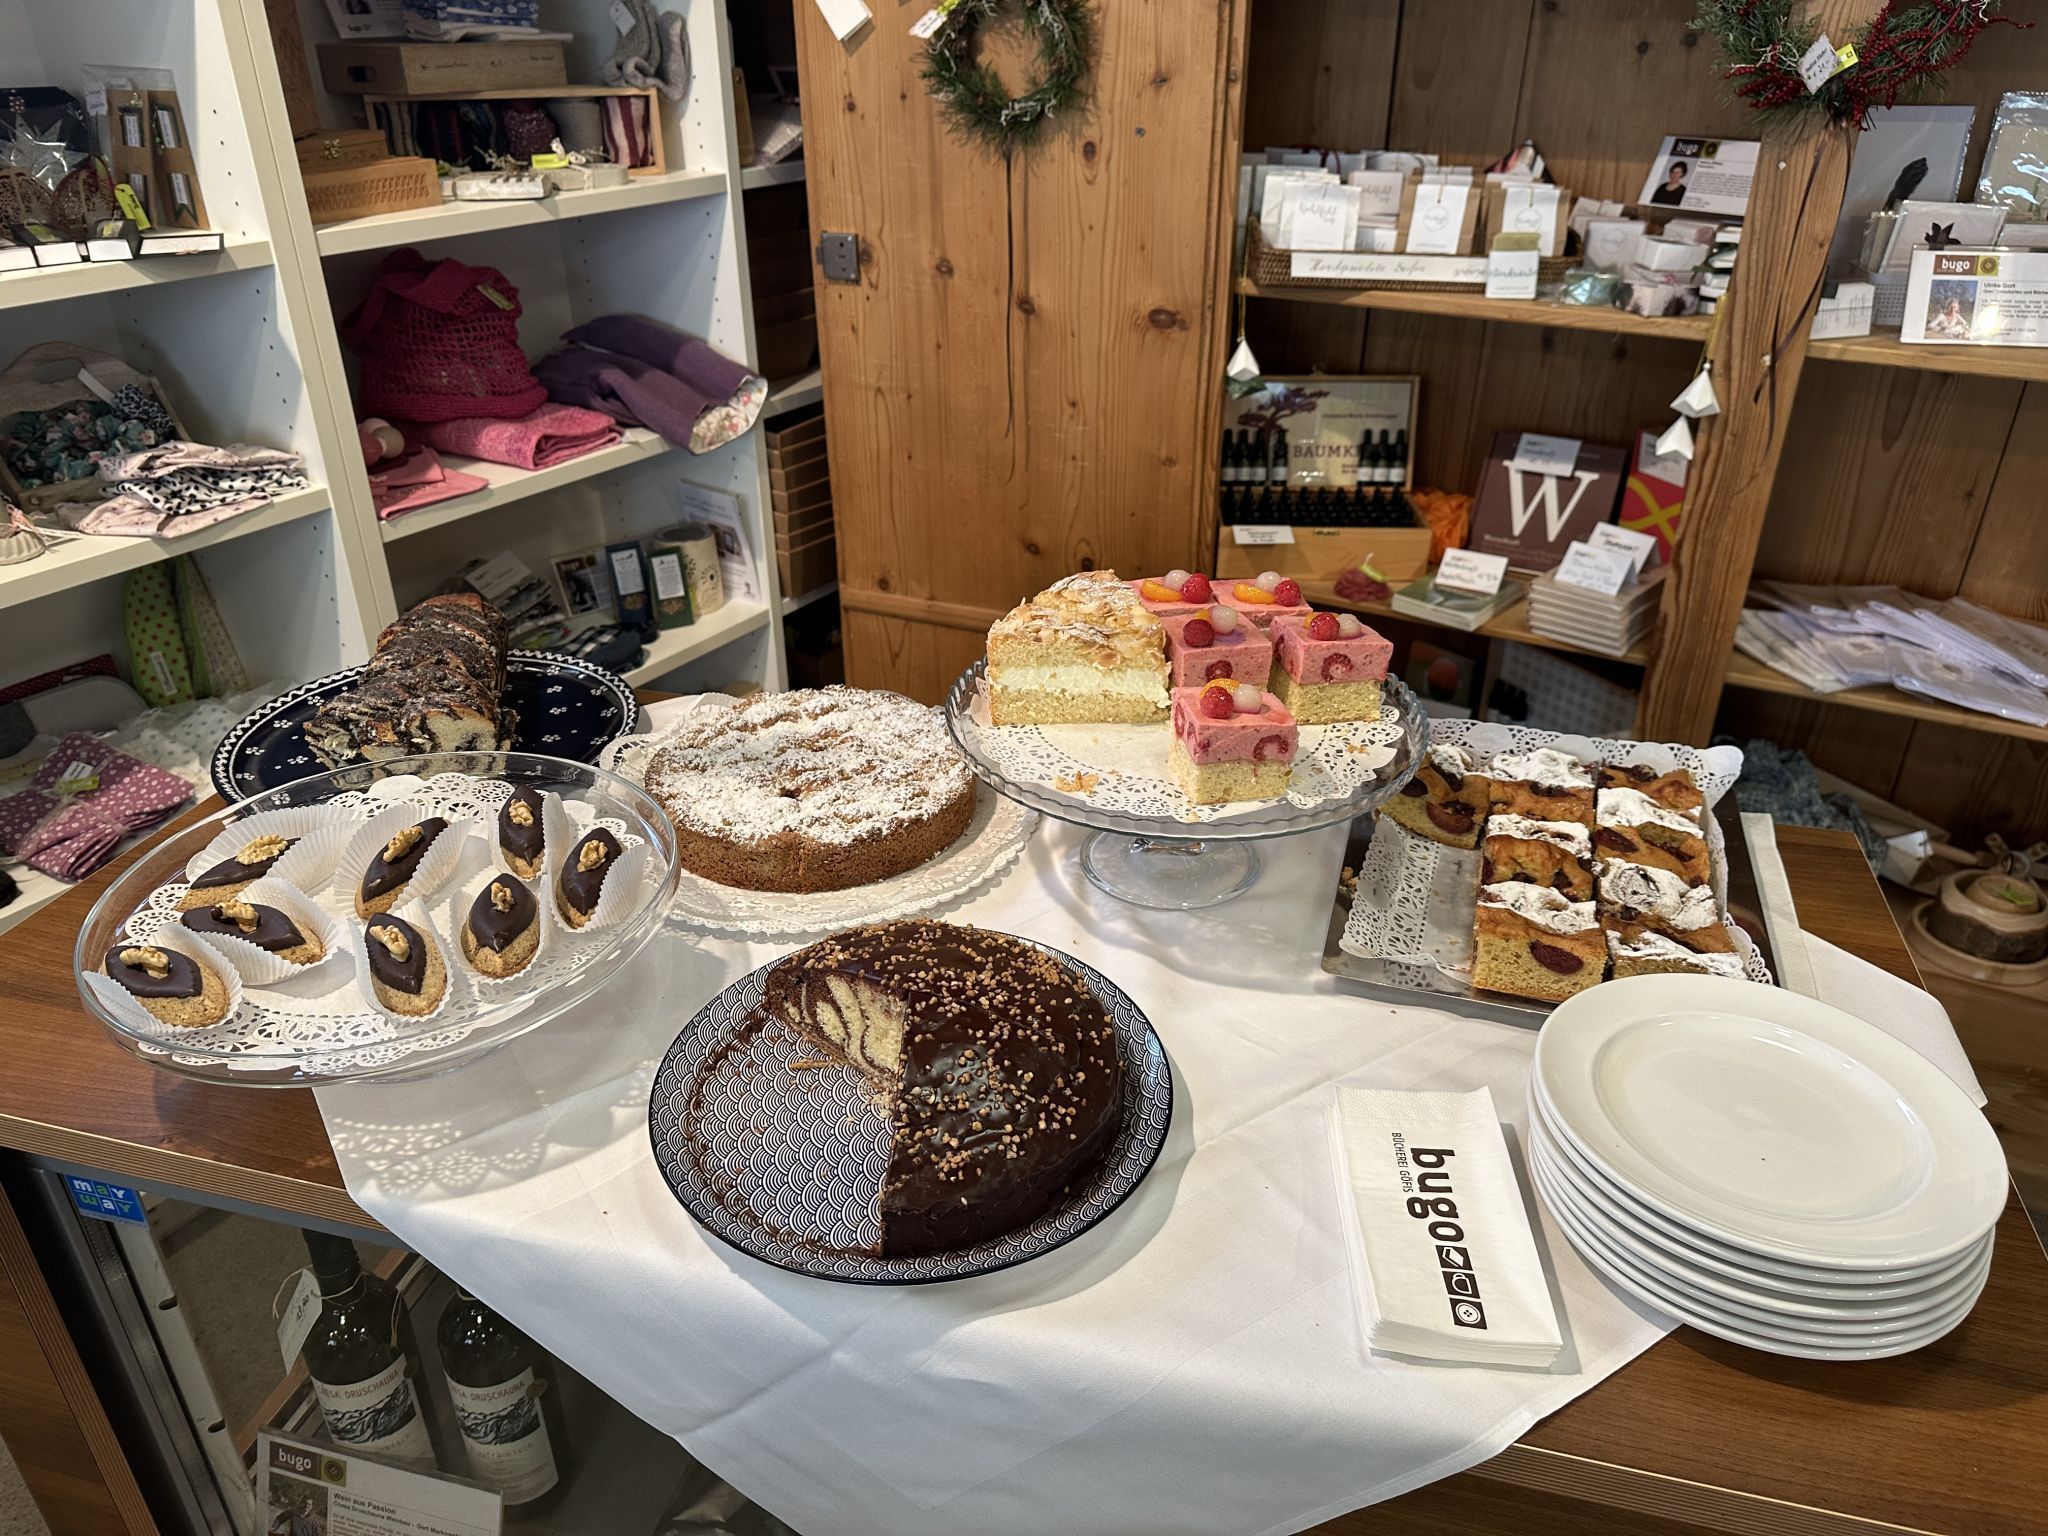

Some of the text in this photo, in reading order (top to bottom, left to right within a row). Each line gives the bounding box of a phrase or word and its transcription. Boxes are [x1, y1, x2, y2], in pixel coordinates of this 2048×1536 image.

[1941, 257, 1971, 273] bugo
[1392, 1133, 1414, 1193] BÜCHEREI GÖFIS
[1406, 1147, 1466, 1243] bugo
[344, 1369, 400, 1400] DRUSCHAUNA
[471, 1380, 526, 1402] DRUSCHAUNA
[278, 1447, 313, 1472] bugo
[333, 1491, 397, 1516] Wein aus Passion
[351, 1504, 386, 1521] Druschauna
[386, 1513, 411, 1528] Weinbau
